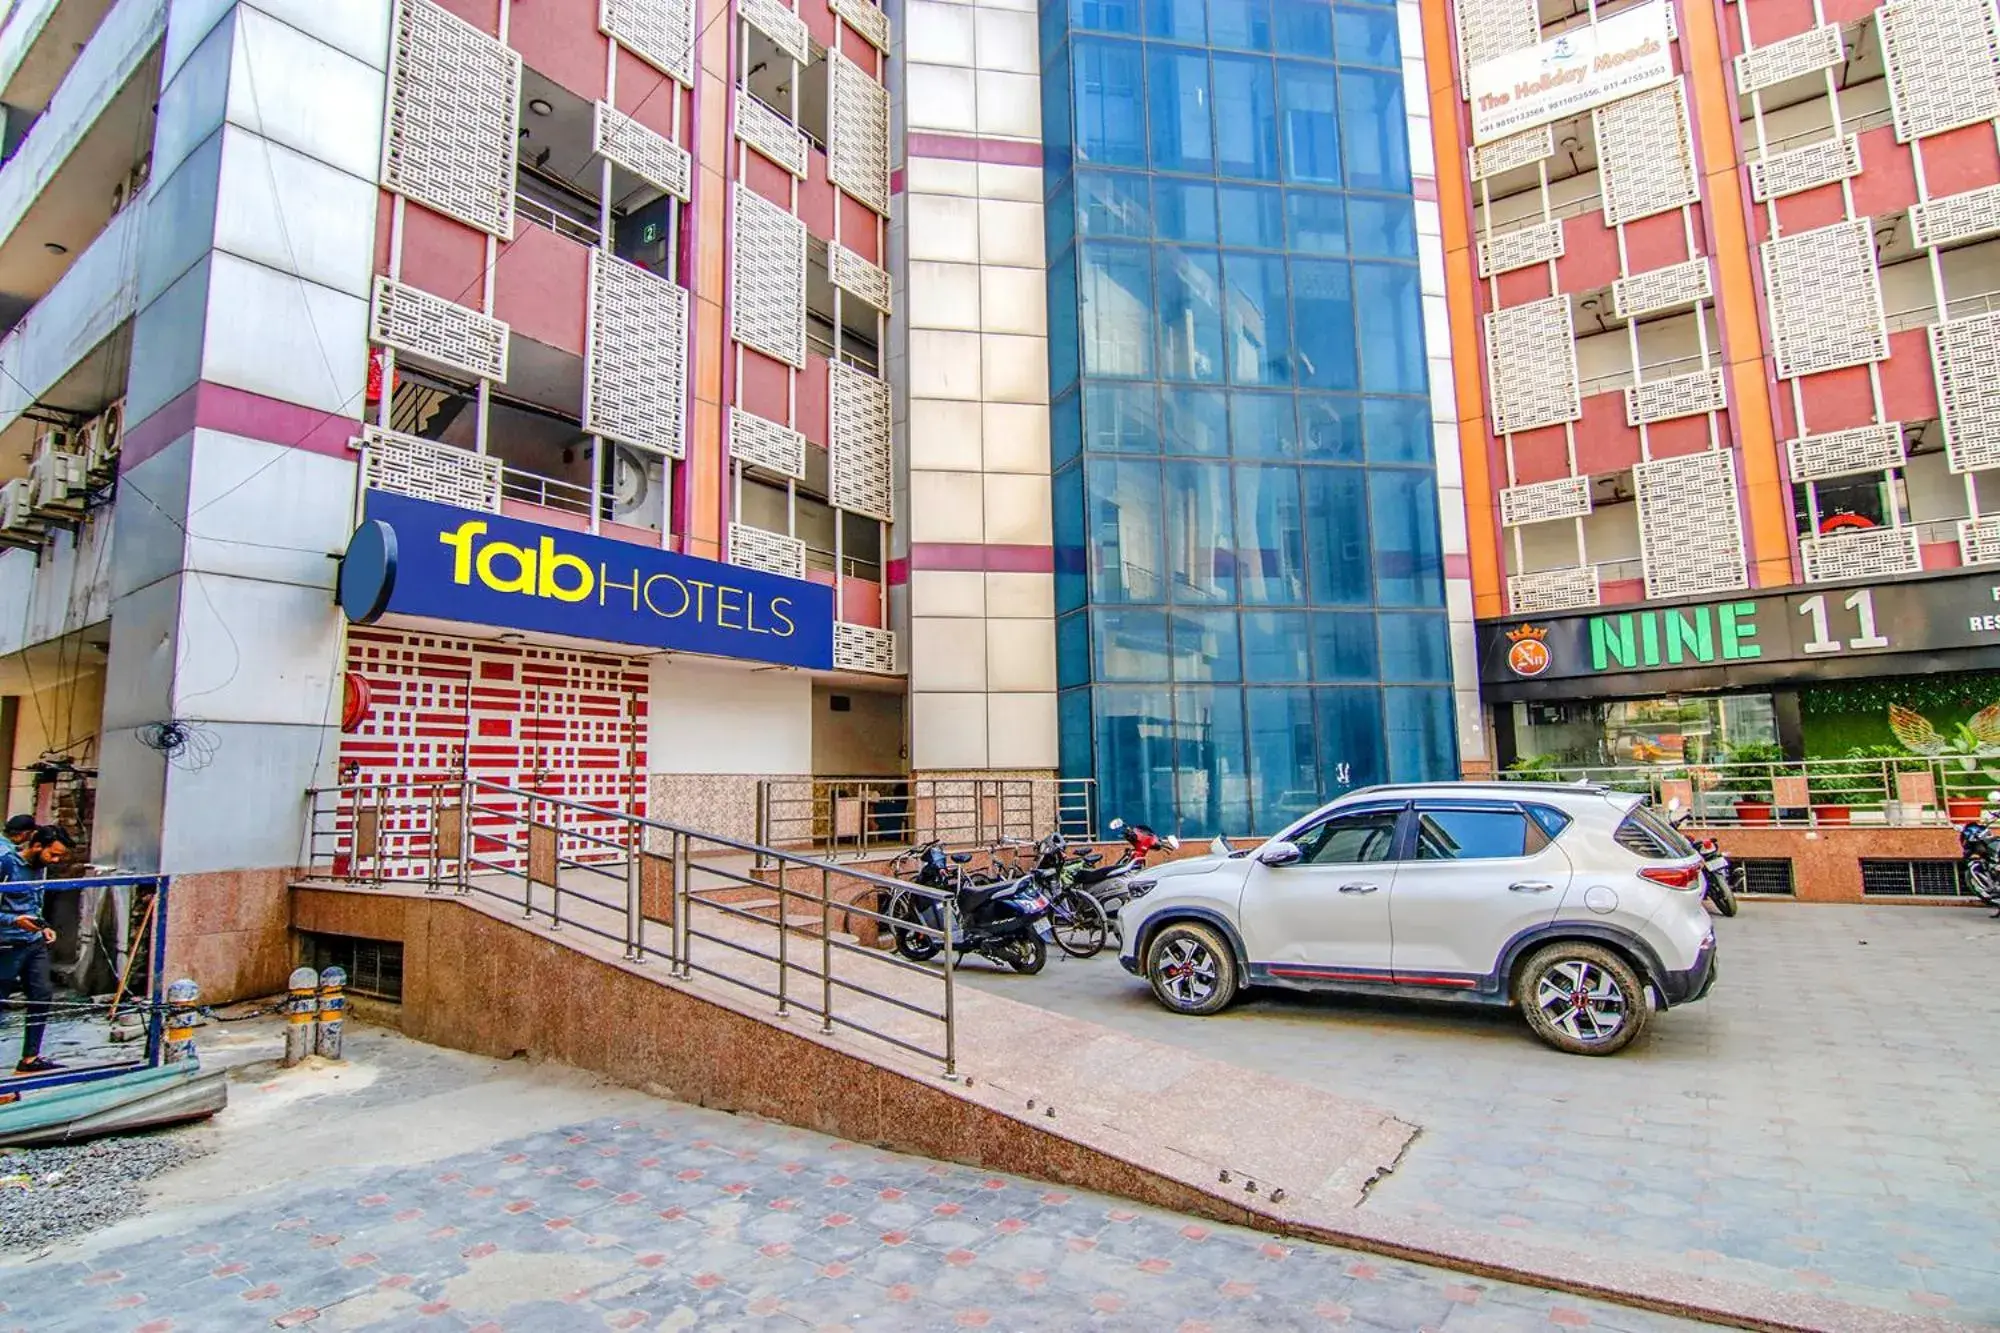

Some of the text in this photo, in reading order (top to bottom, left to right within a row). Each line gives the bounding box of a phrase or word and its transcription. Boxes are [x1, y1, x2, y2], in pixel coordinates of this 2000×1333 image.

[1478, 91, 1510, 112] The
[1514, 66, 1588, 100] Holiday
[1592, 37, 1662, 73] Moods
[1590, 589, 1889, 670] NINE 11
